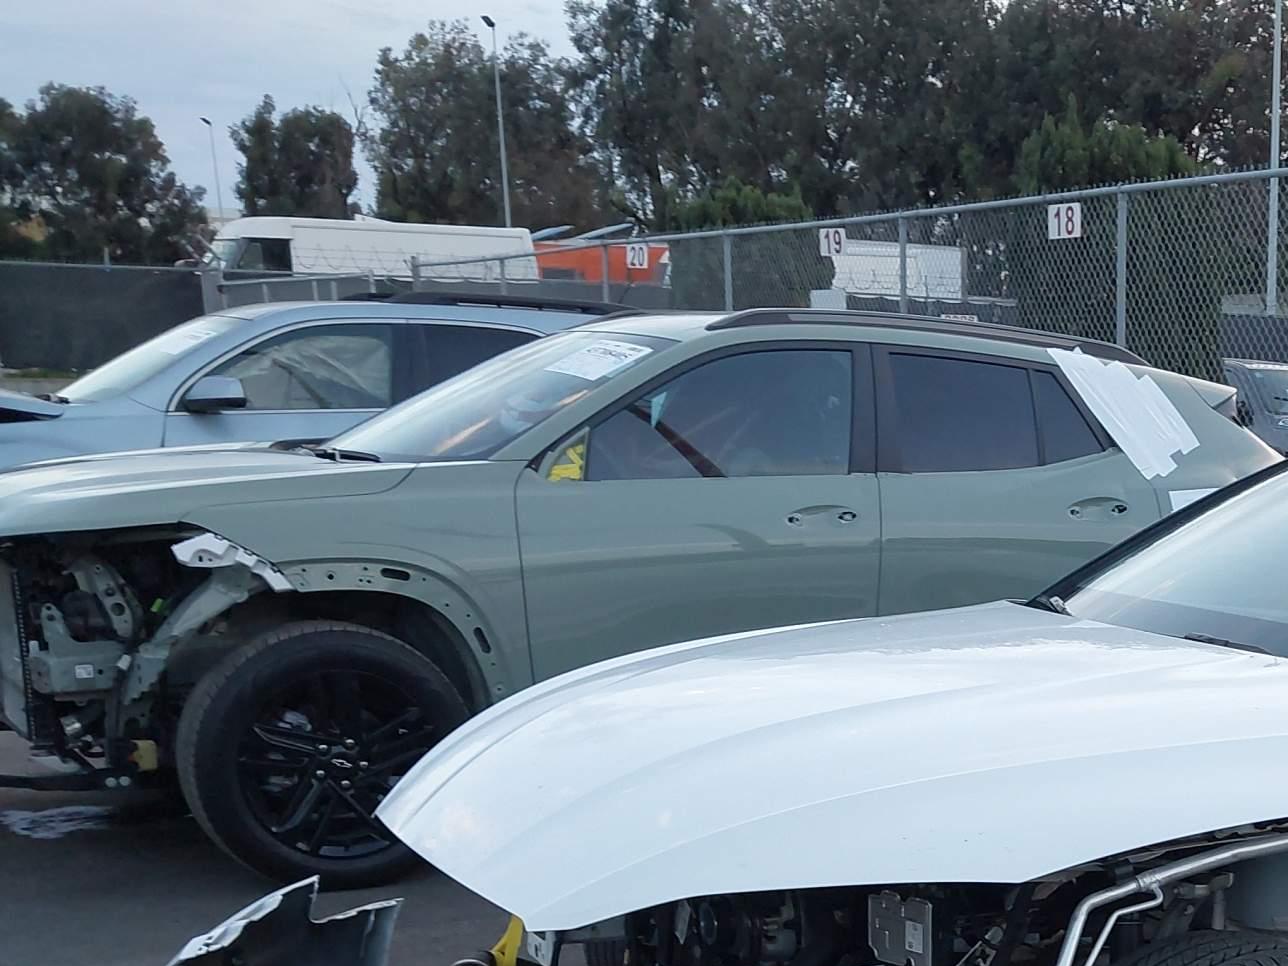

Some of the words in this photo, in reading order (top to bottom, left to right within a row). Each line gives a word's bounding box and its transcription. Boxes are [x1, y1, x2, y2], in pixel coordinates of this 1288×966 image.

[1053, 205, 1075, 237] 18
[823, 229, 842, 255] 19
[630, 246, 645, 267] 20
